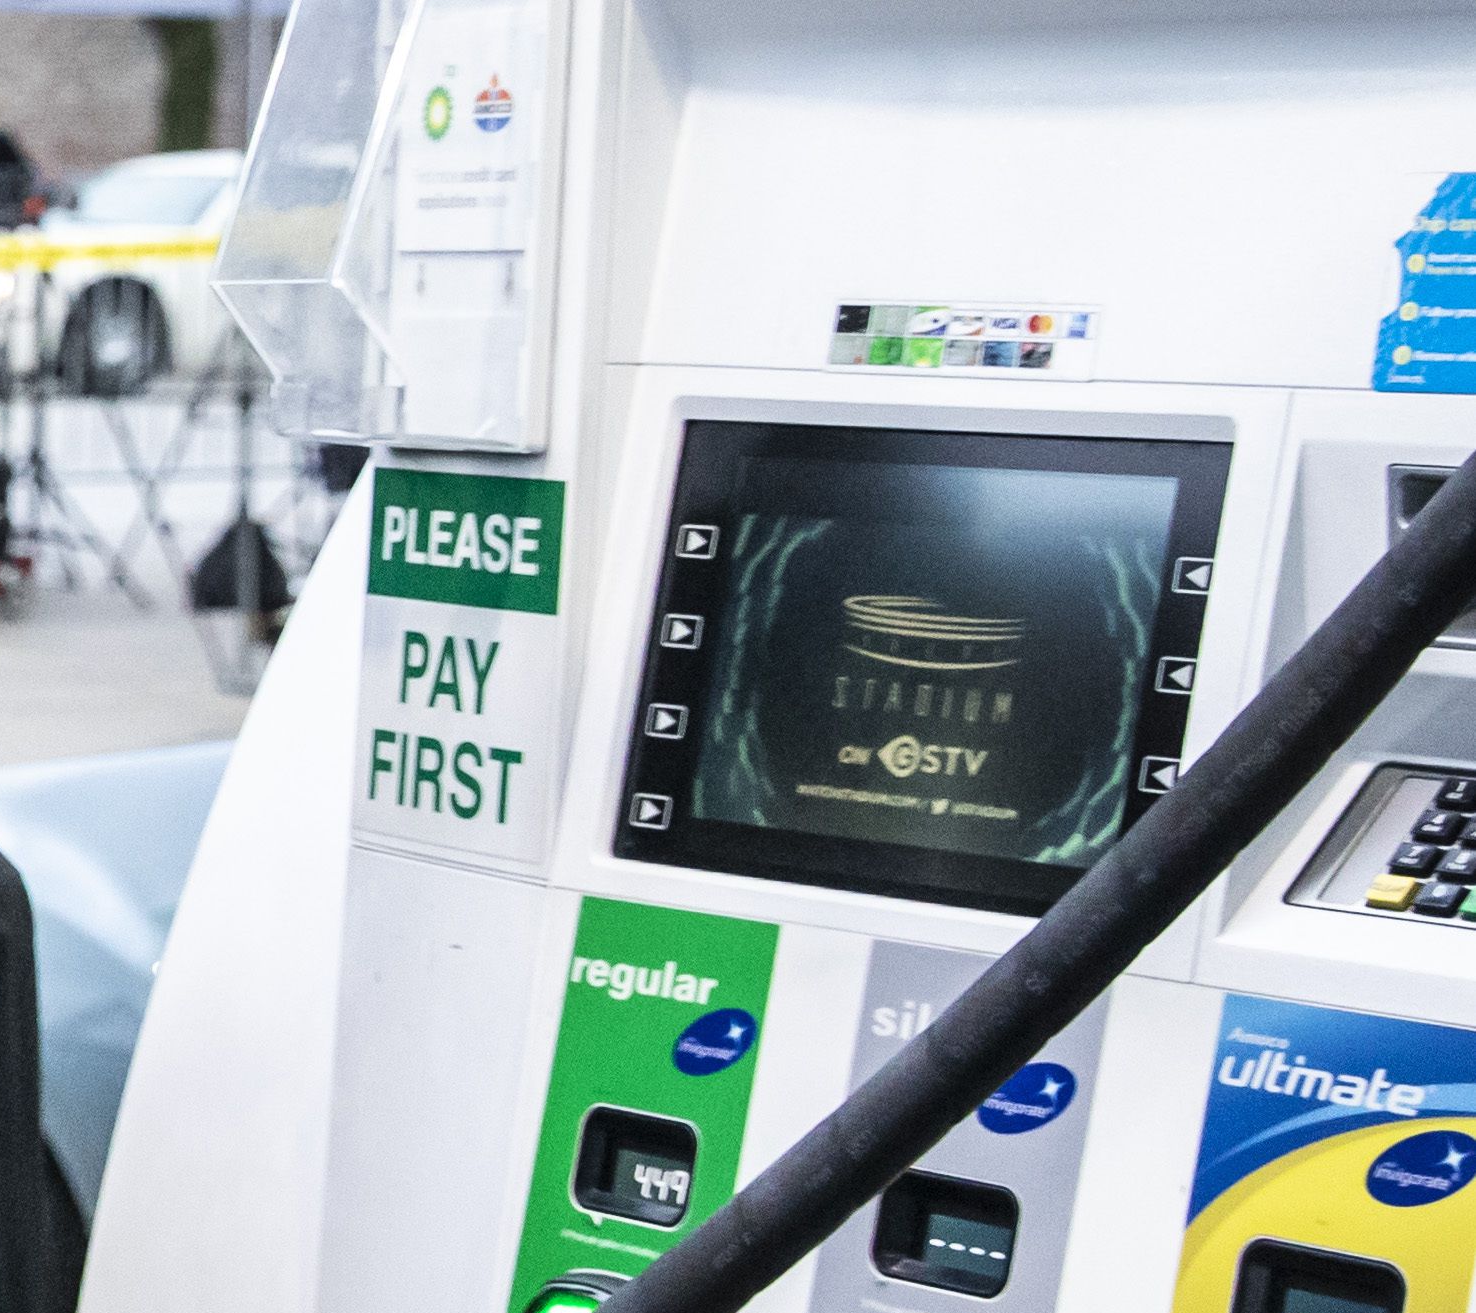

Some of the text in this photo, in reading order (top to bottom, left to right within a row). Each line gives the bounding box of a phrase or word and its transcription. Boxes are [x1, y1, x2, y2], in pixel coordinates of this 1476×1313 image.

[381, 504, 543, 577] PLEASE
[398, 630, 501, 716] PAY
[367, 728, 524, 825] FIRST
[570, 955, 720, 1005] regular
[871, 1000, 936, 1040] sil
[1217, 1049, 1426, 1117] ultimate
